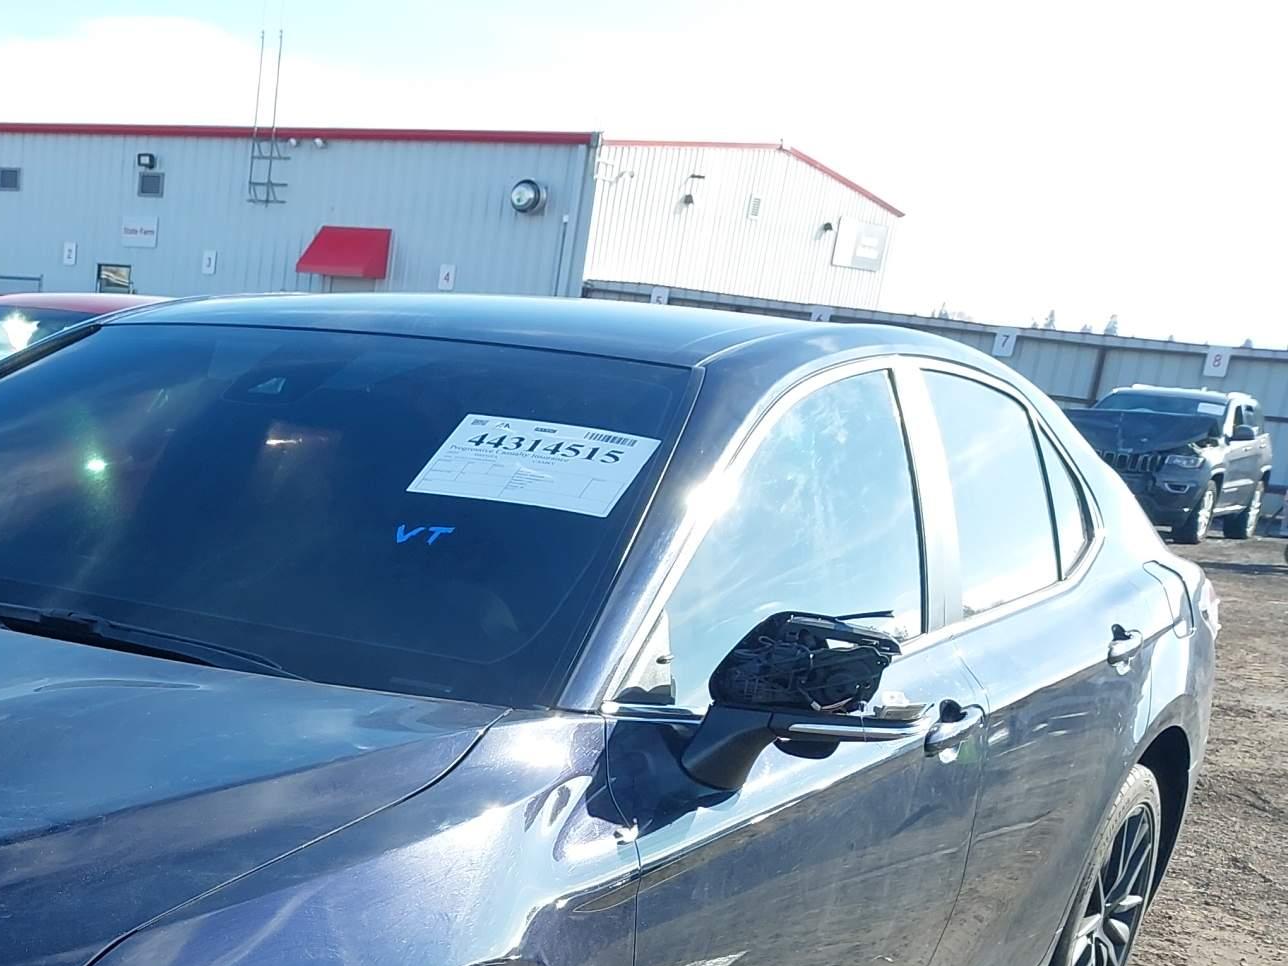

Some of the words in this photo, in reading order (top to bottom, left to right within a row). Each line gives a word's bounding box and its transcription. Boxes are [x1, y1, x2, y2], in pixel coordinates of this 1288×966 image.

[443, 271, 450, 283] 4
[1001, 334, 1011, 348] 7
[1212, 353, 1222, 368] 8
[467, 432, 625, 465] 44314515
[396, 524, 457, 545] VT
